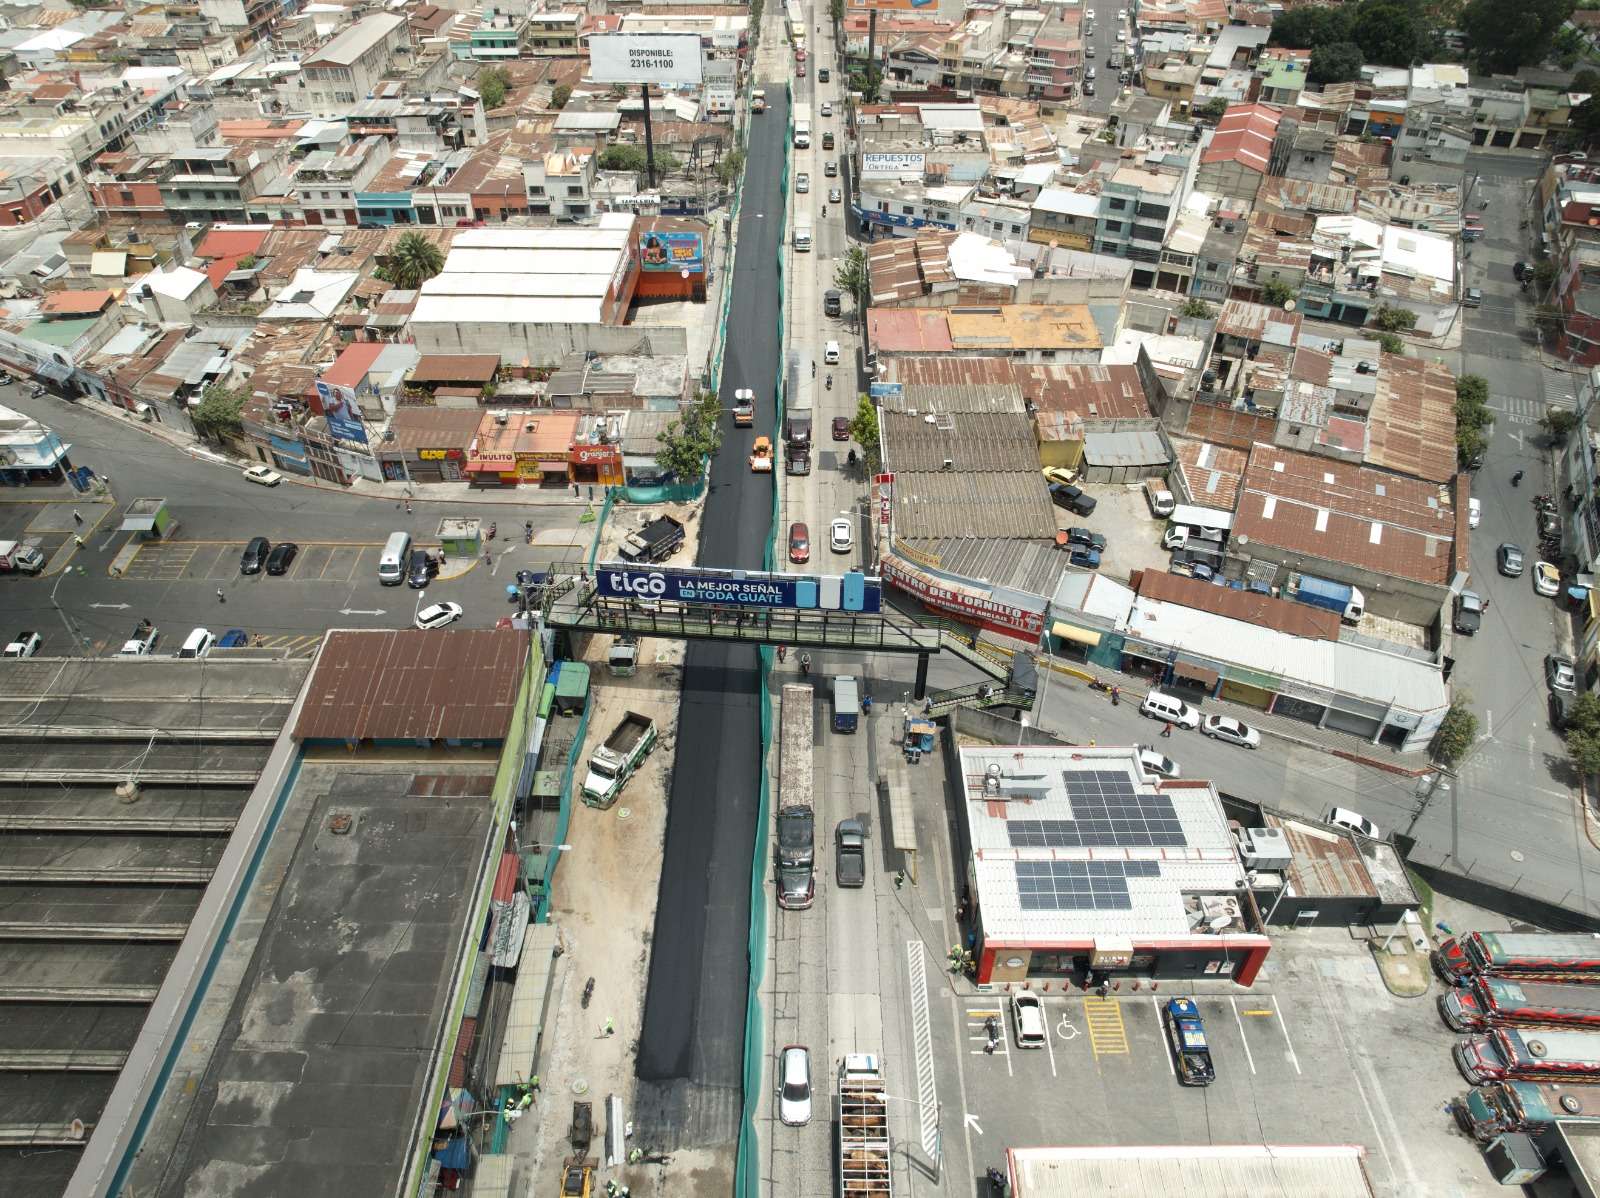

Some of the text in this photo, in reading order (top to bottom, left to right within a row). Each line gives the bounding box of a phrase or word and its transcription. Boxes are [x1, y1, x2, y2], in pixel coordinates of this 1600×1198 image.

[629, 49, 673, 57] DISPONIBLE:
[630, 59, 674, 69] 2316-1100
[865, 154, 922, 162] REPUESTOS
[678, 579, 783, 595] LA MEJOR SEÑAL
[883, 562, 927, 591] CENTRO
[929, 586, 953, 600] DEL
[957, 593, 1022, 618] TORNILLO
[698, 590, 735, 601] TODA
[737, 593, 783, 604] GUATE
